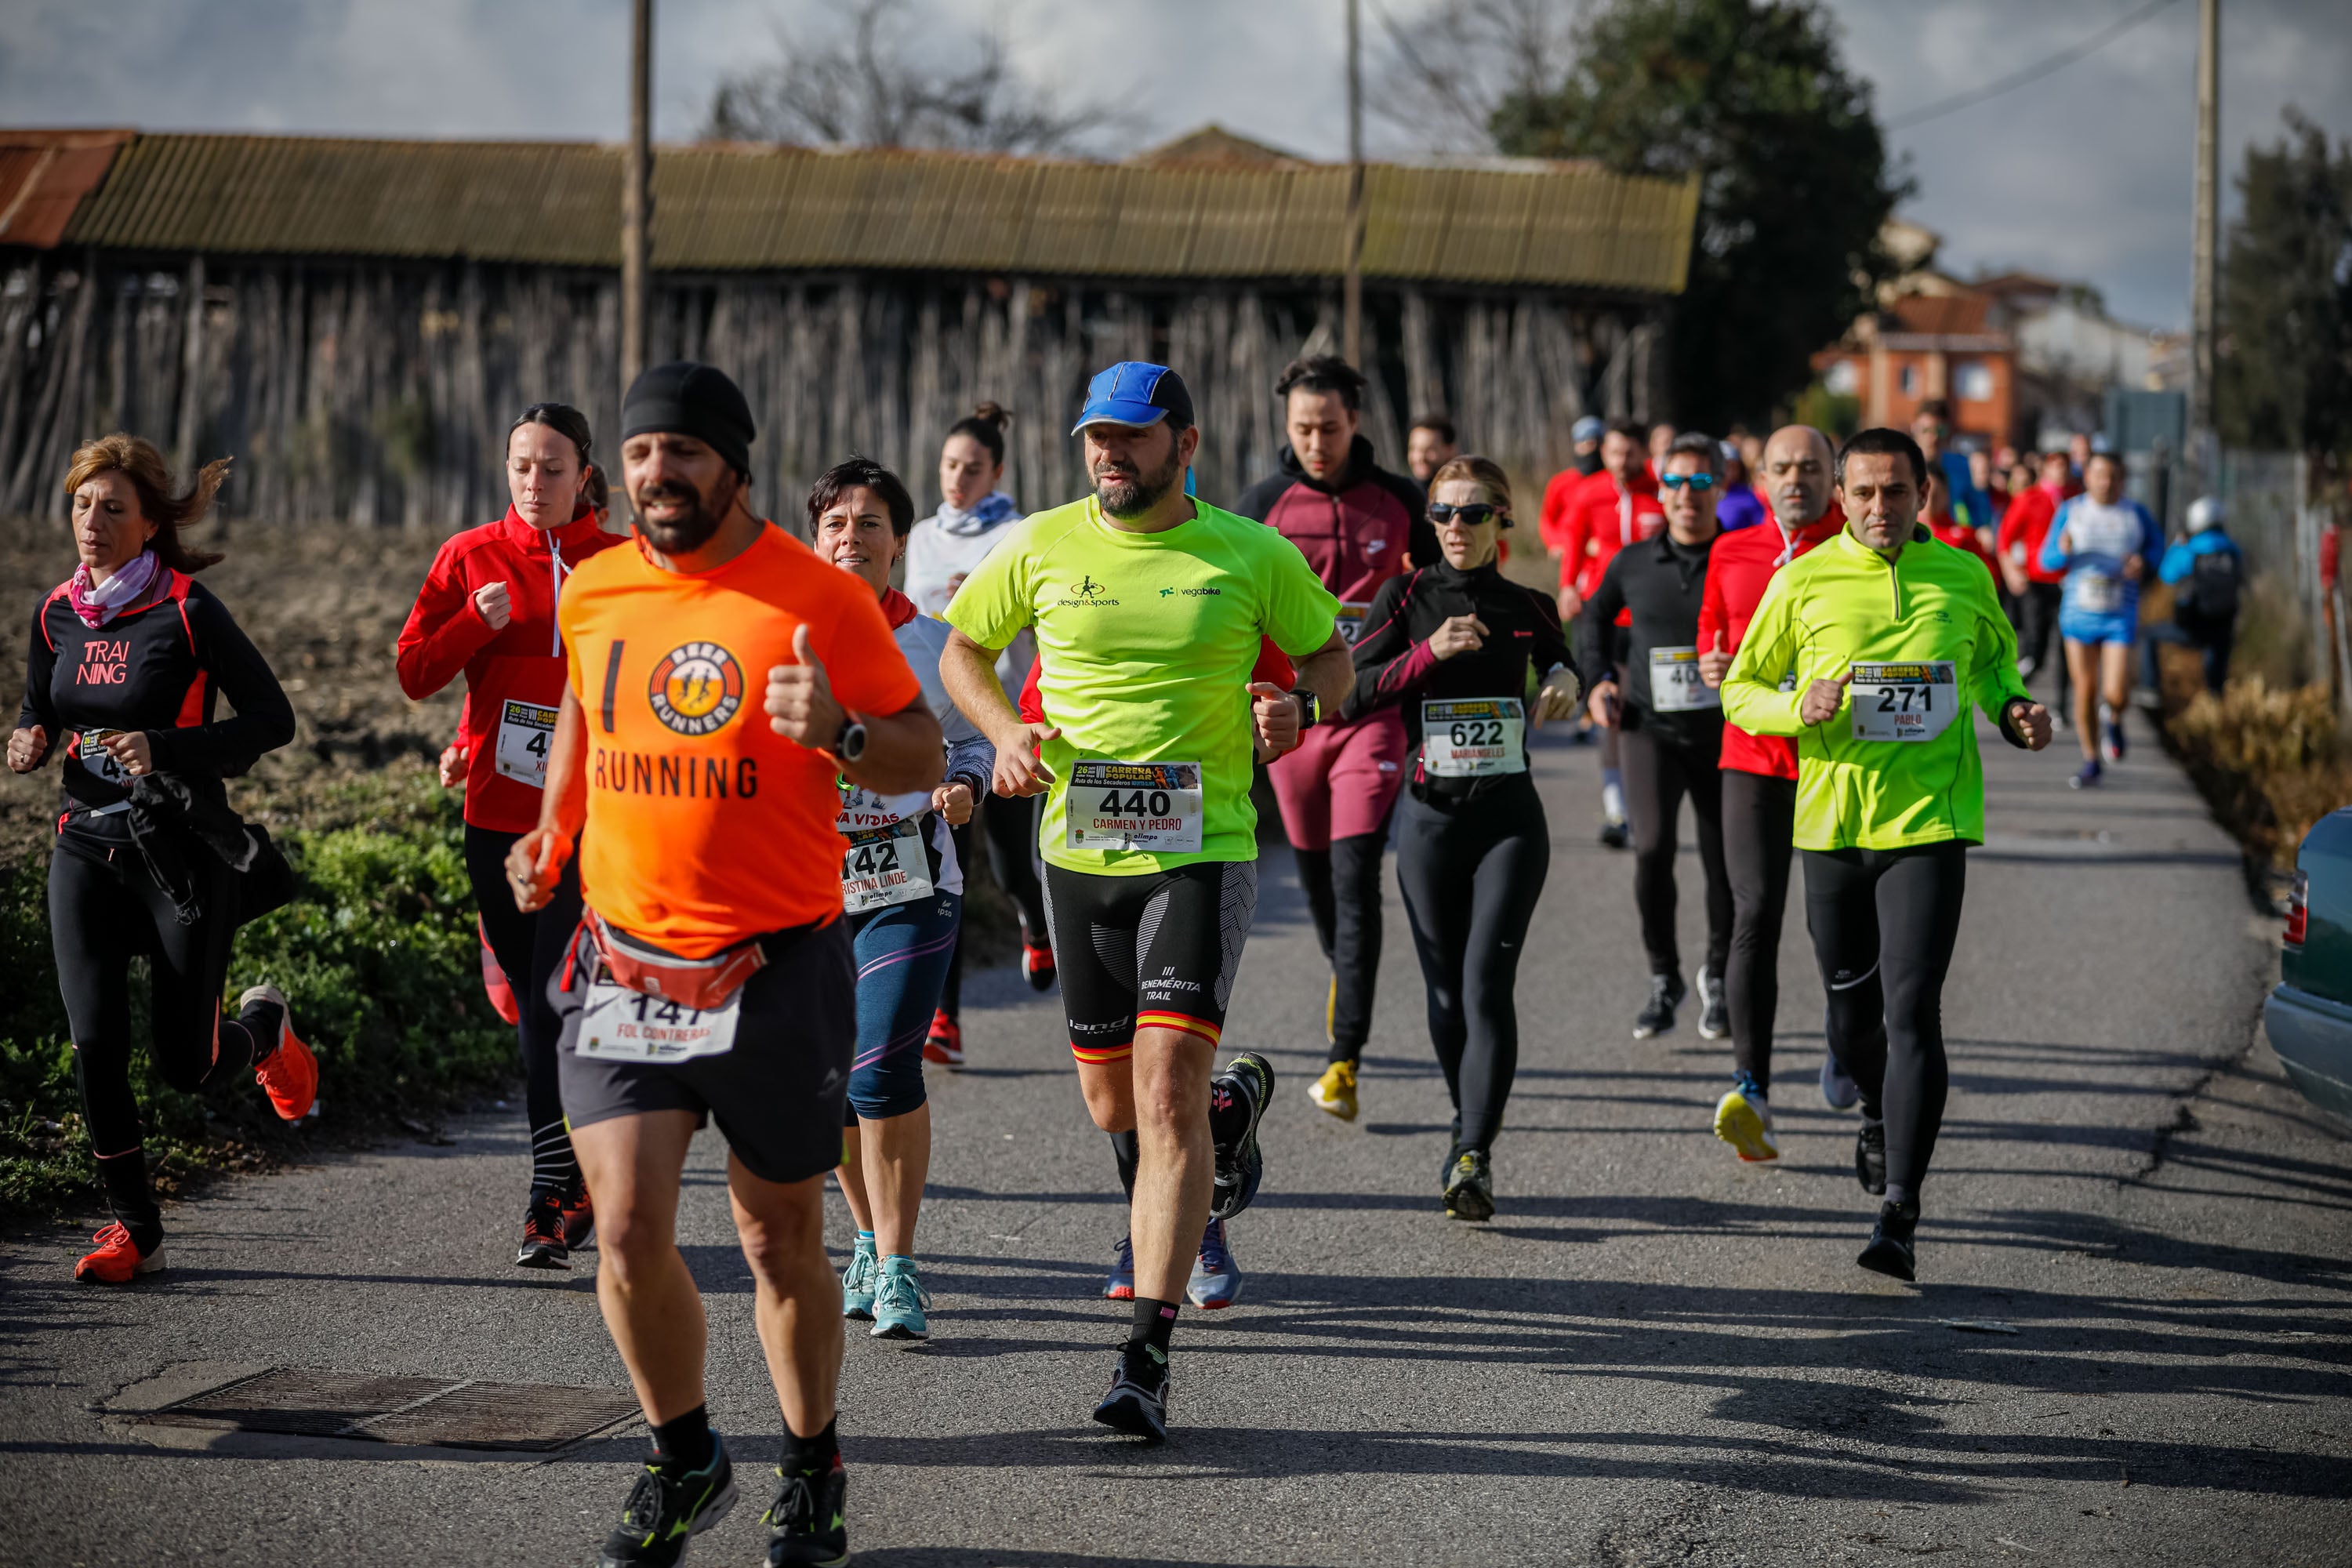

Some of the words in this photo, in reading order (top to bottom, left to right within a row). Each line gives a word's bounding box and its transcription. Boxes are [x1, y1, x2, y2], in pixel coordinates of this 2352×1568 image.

[1181, 587, 1221, 597] vegabike
[1058, 599, 1120, 608] design&sports
[83, 641, 130, 662] TRAI
[671, 643, 728, 666] BEER
[76, 663, 128, 685] NING
[602, 640, 625, 733] I
[510, 705, 521, 713] 26
[1878, 686, 1931, 712] 271
[652, 693, 738, 734] RUNNERS
[1894, 714, 1922, 725] PABLO
[1450, 721, 1503, 746] 622
[526, 731, 552, 758] 4
[102, 754, 130, 779] 4
[596, 748, 758, 799] RUNNING
[1096, 765, 1105, 779] VII
[1099, 789, 1171, 818] 440
[855, 813, 899, 826] VIDAS
[1093, 818, 1137, 830] CARMEN
[1139, 820, 1146, 830] Y
[1149, 818, 1181, 831] PEDRO
[842, 877, 879, 895] RISTINA
[880, 871, 908, 887] LINDE
[869, 891, 893, 899] olimpo
[1162, 966, 1175, 976] III
[1142, 977, 1201, 993] BENEMÉRITA
[1146, 991, 1171, 1000] TRAIL
